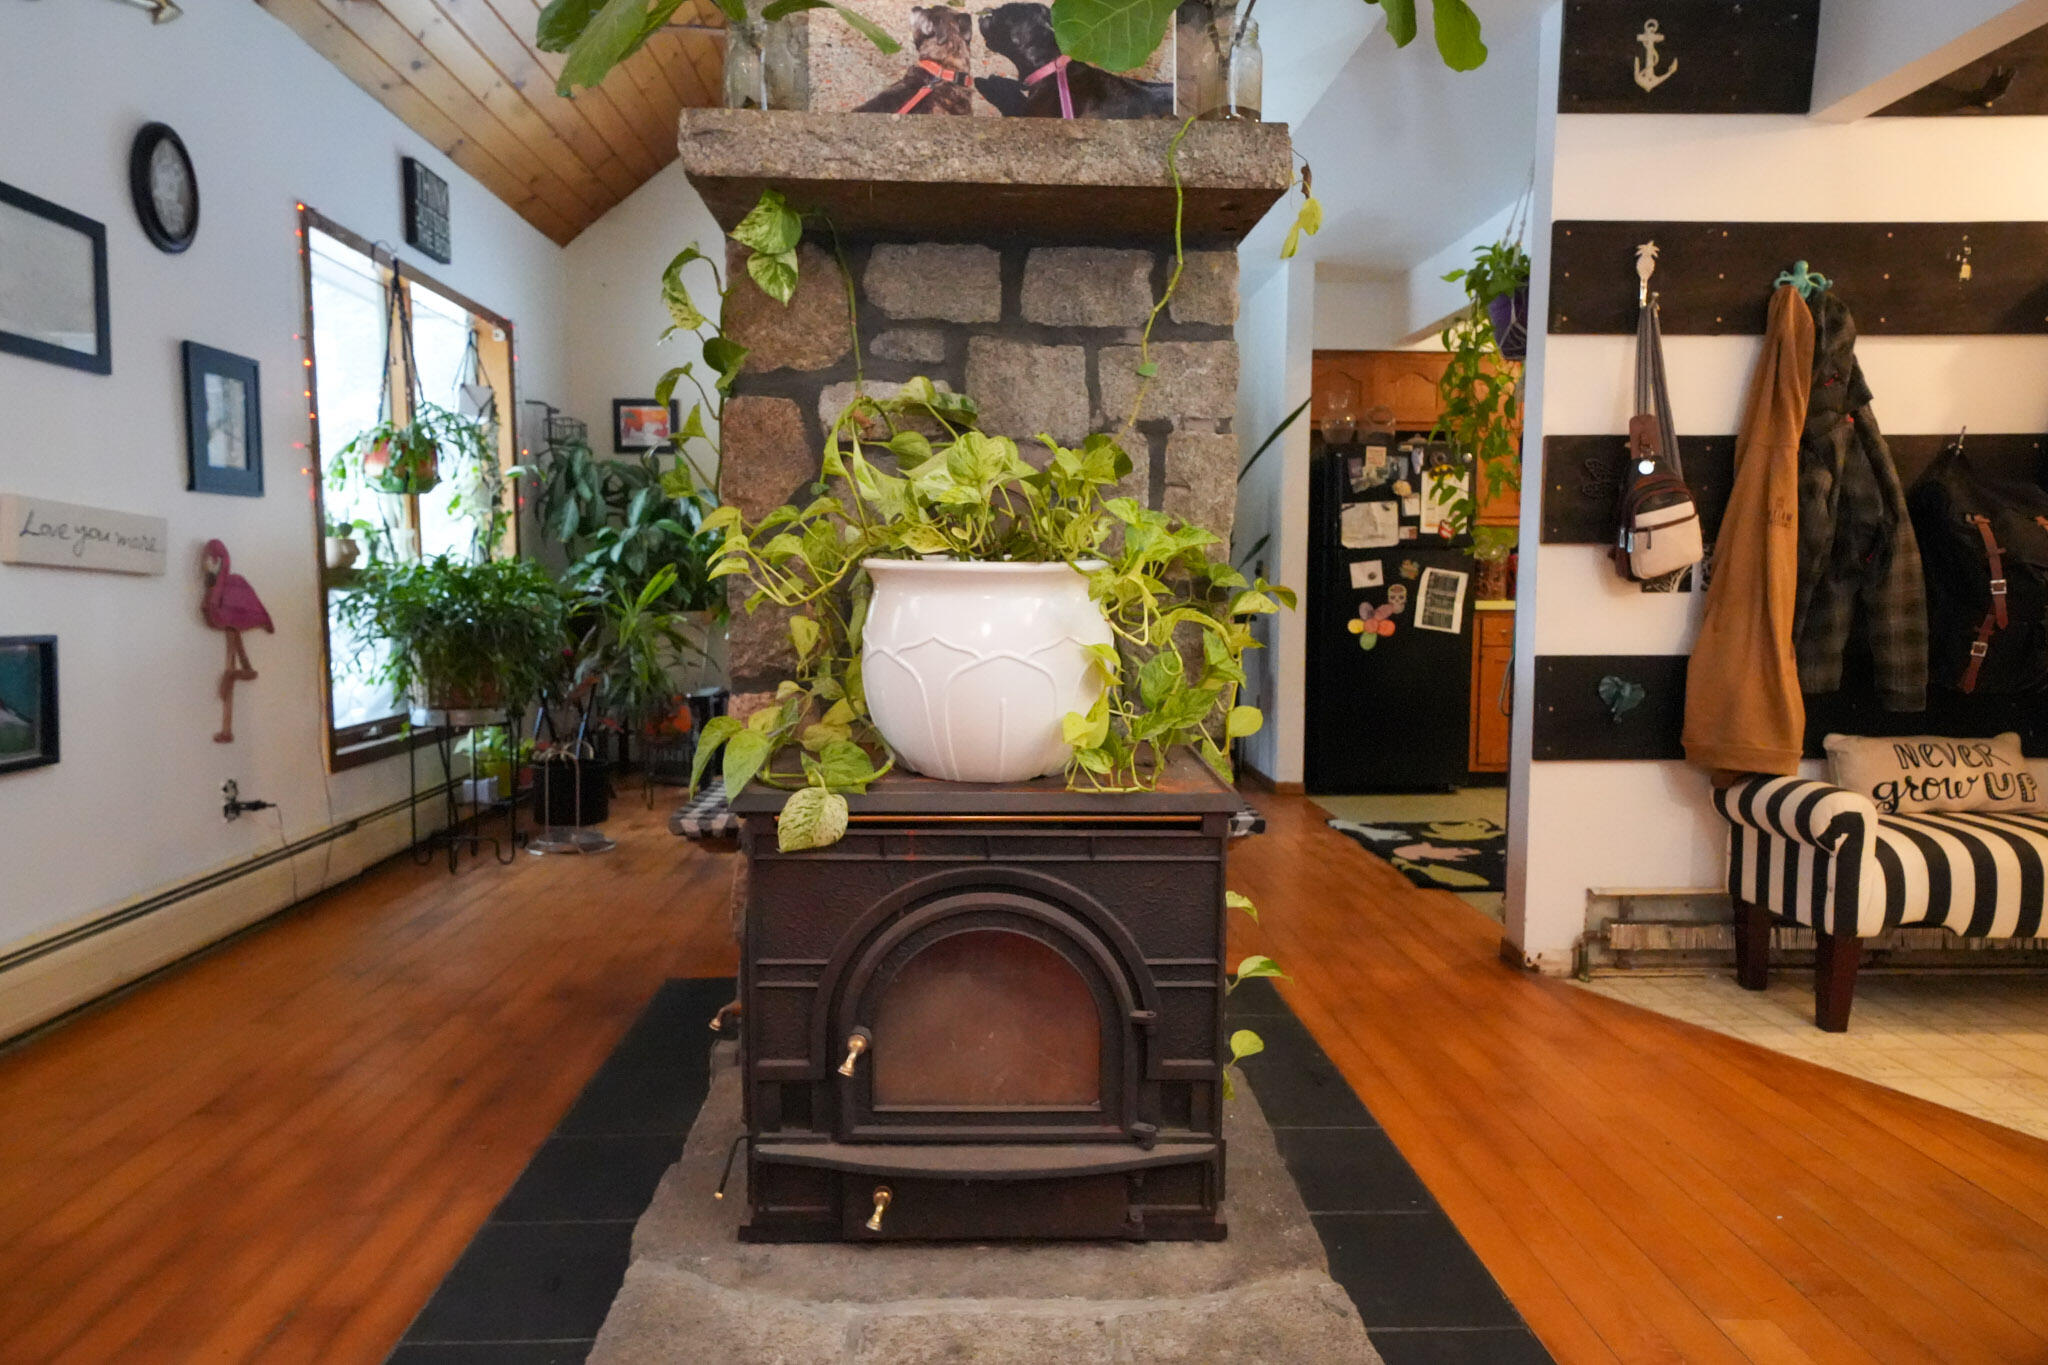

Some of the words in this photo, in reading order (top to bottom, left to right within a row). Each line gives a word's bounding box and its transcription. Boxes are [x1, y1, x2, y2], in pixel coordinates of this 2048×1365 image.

[19, 509, 70, 540] Love
[73, 524, 109, 557] you
[115, 532, 158, 552] more
[1872, 775, 1979, 814] grow
[1983, 772, 2038, 803] UP
